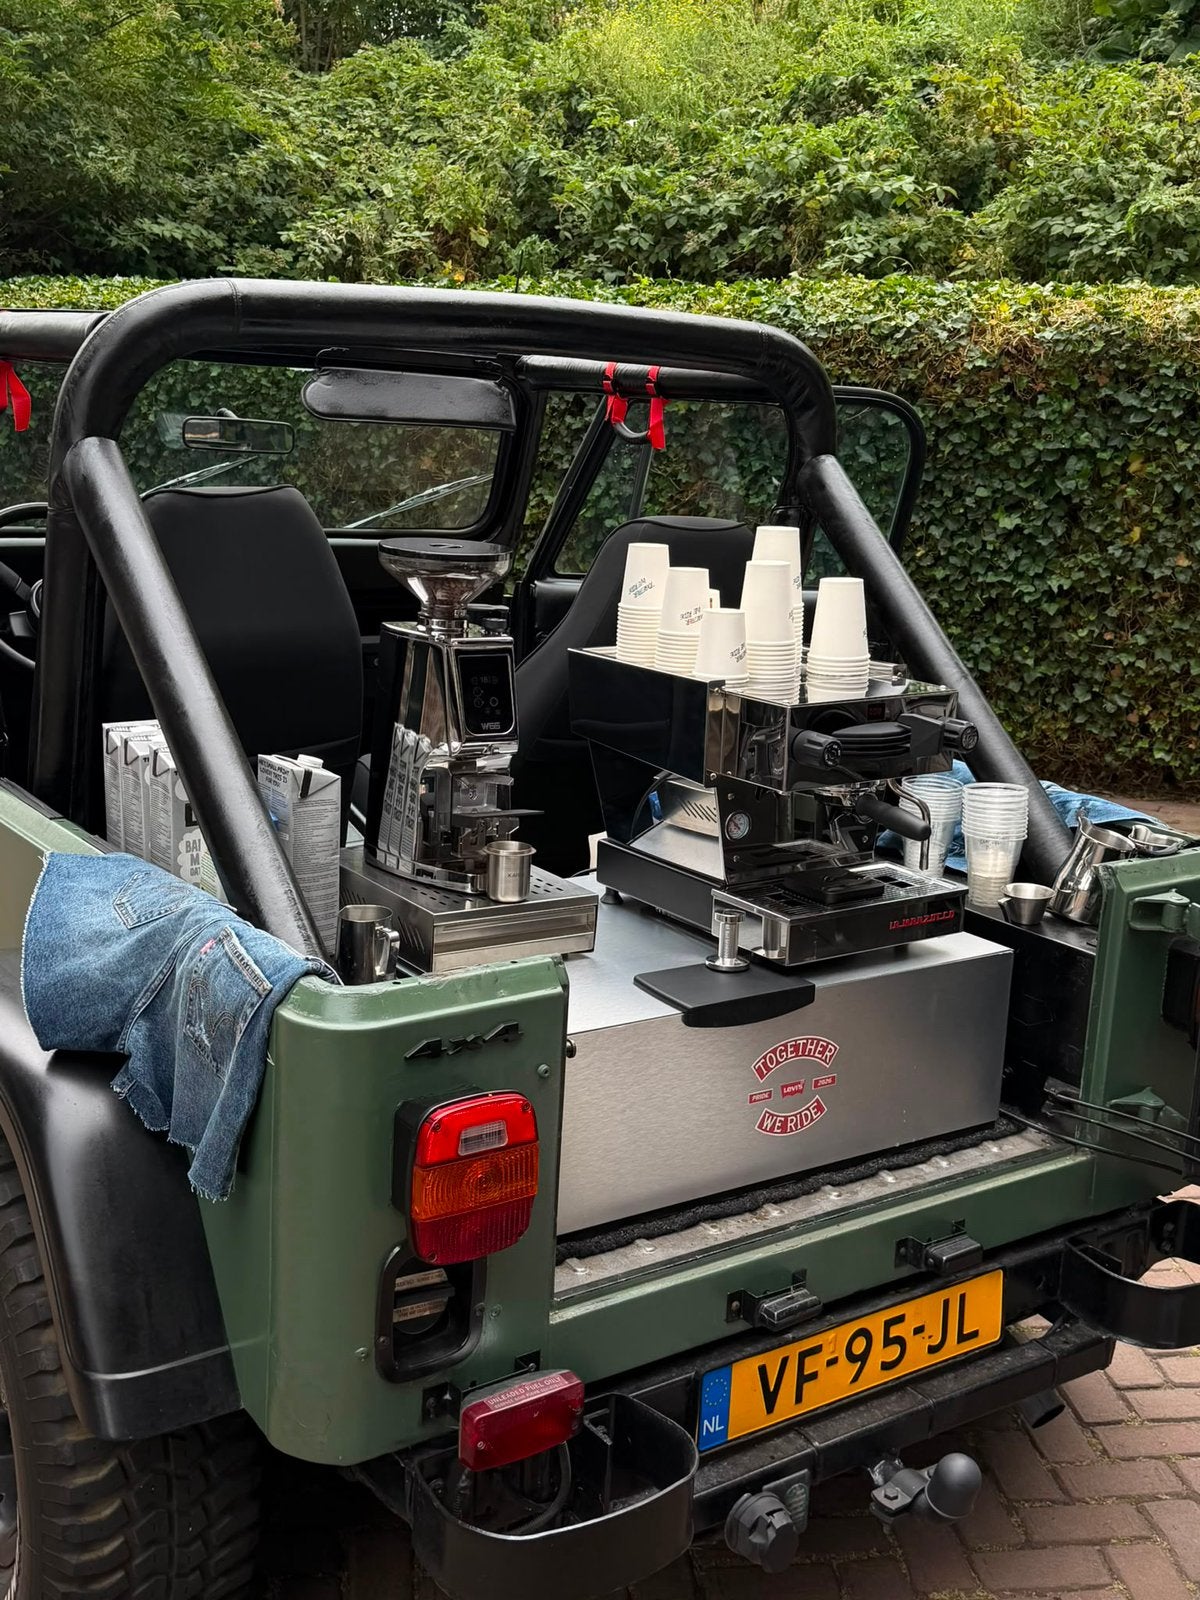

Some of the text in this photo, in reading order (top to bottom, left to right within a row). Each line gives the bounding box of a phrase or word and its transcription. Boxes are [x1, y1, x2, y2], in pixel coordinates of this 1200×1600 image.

[755, 1039, 835, 1076] TOGETHER
[761, 1102, 821, 1133] WE RIDE
[757, 1292, 980, 1415] VF-95-JL
[487, 1388, 525, 1405] UNLEADED
[525, 1382, 545, 1393] FUEL
[544, 1375, 561, 1387] ONLY
[702, 1415, 725, 1437] NL
